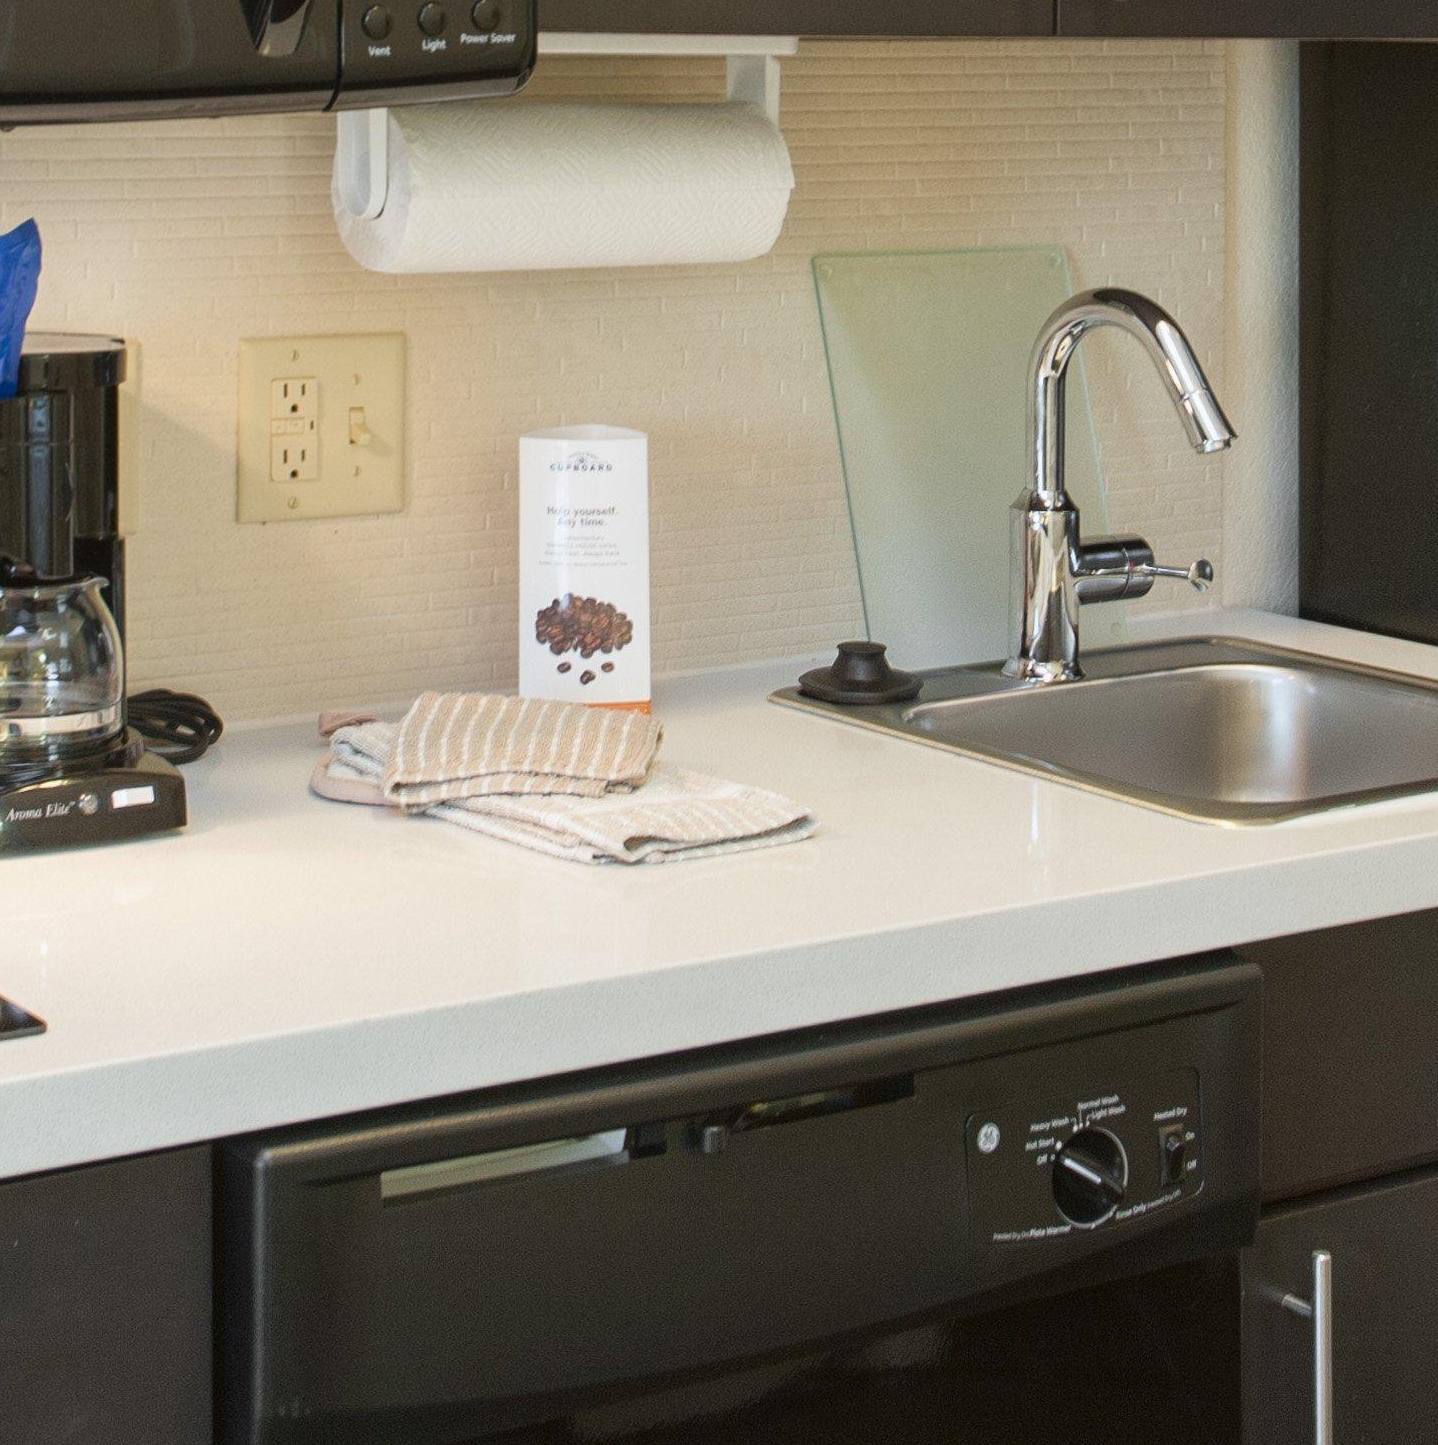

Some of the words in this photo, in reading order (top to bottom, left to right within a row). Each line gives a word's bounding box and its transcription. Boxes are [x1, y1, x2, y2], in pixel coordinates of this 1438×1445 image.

[461, 33, 489, 44] Power
[491, 33, 516, 44] Saver
[368, 45, 392, 57] Vent
[422, 39, 447, 53] Light
[574, 506, 618, 518] yourself.
[580, 517, 608, 527] time.
[5, 808, 42, 821] Aroma
[45, 802, 71, 818] Elite
[1101, 1094, 1120, 1105] Wash
[1052, 1117, 1069, 1127] Wash
[1185, 1131, 1195, 1141] On
